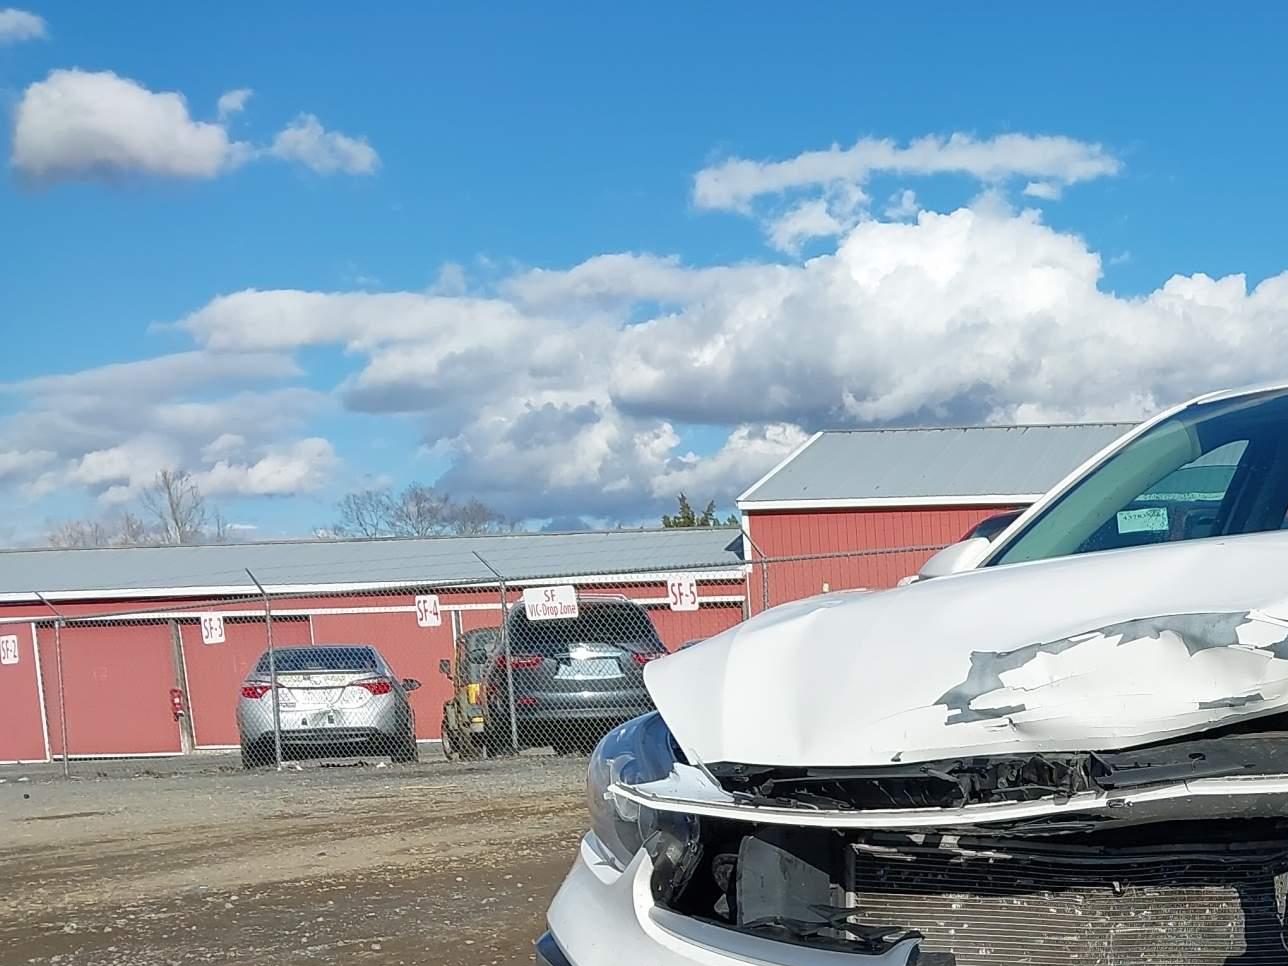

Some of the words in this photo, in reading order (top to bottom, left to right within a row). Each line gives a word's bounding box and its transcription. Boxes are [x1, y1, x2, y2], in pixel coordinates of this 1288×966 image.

[544, 588, 557, 603] SF
[671, 582, 696, 606] SF-5
[417, 599, 439, 623] SF-4
[558, 601, 577, 615] Zone
[204, 618, 223, 640] SF-3
[1, 640, 18, 660] SF-2
